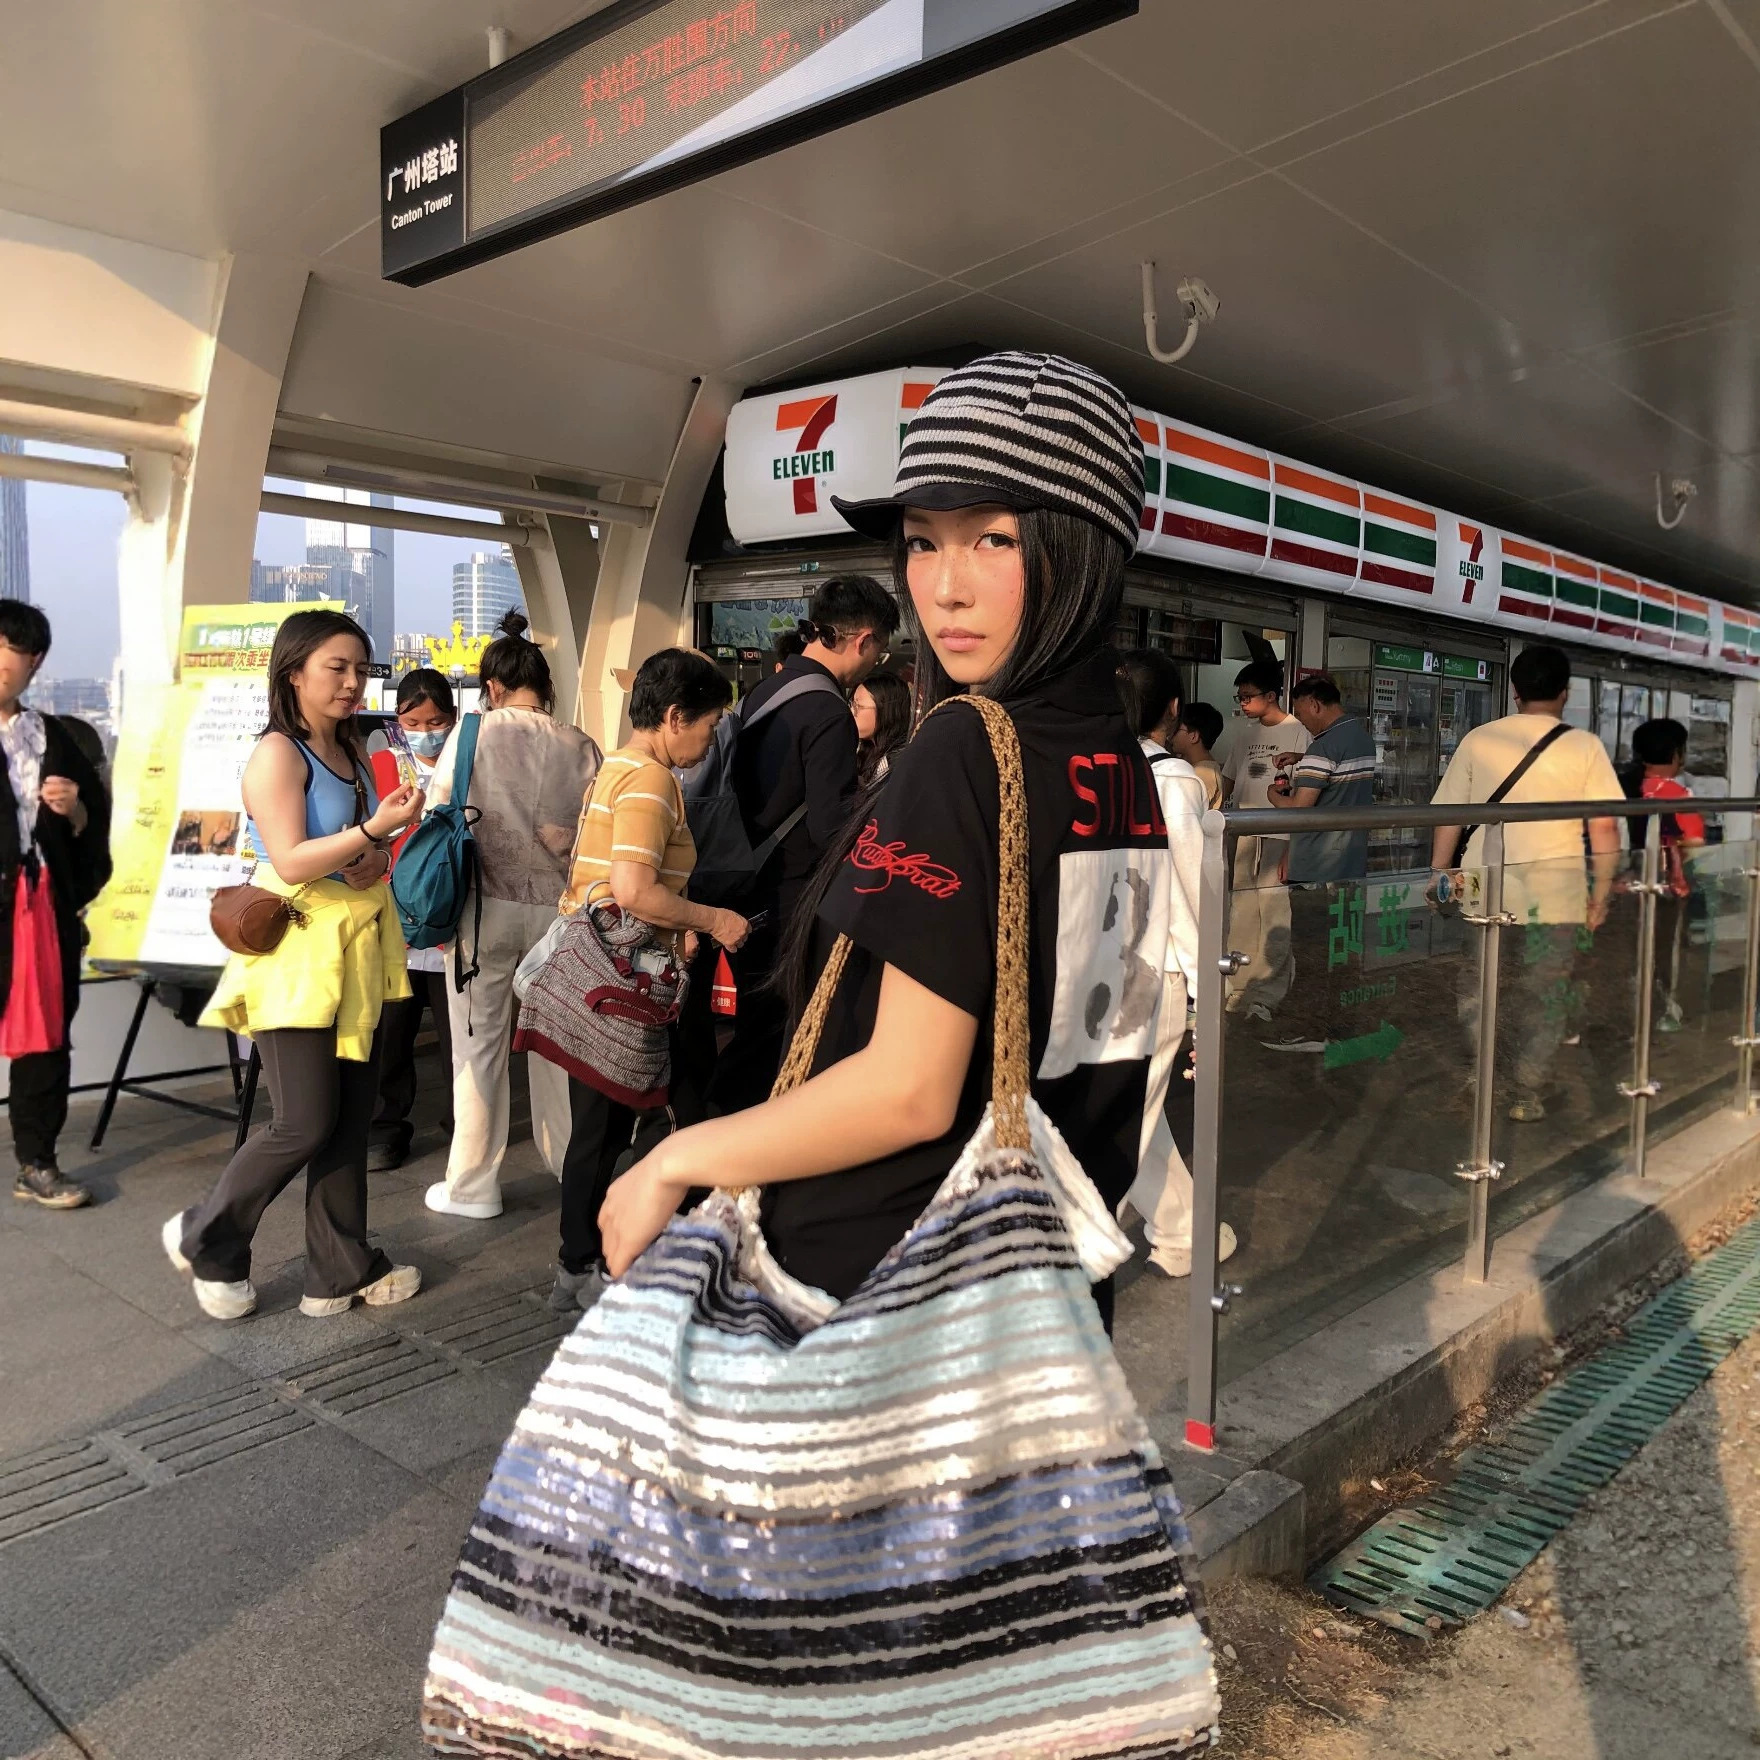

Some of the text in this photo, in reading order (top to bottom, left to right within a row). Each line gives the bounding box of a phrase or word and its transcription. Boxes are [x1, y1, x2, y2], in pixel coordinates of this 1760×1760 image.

[387, 139, 458, 202] 广州塔站
[391, 193, 454, 231] Canton Tower
